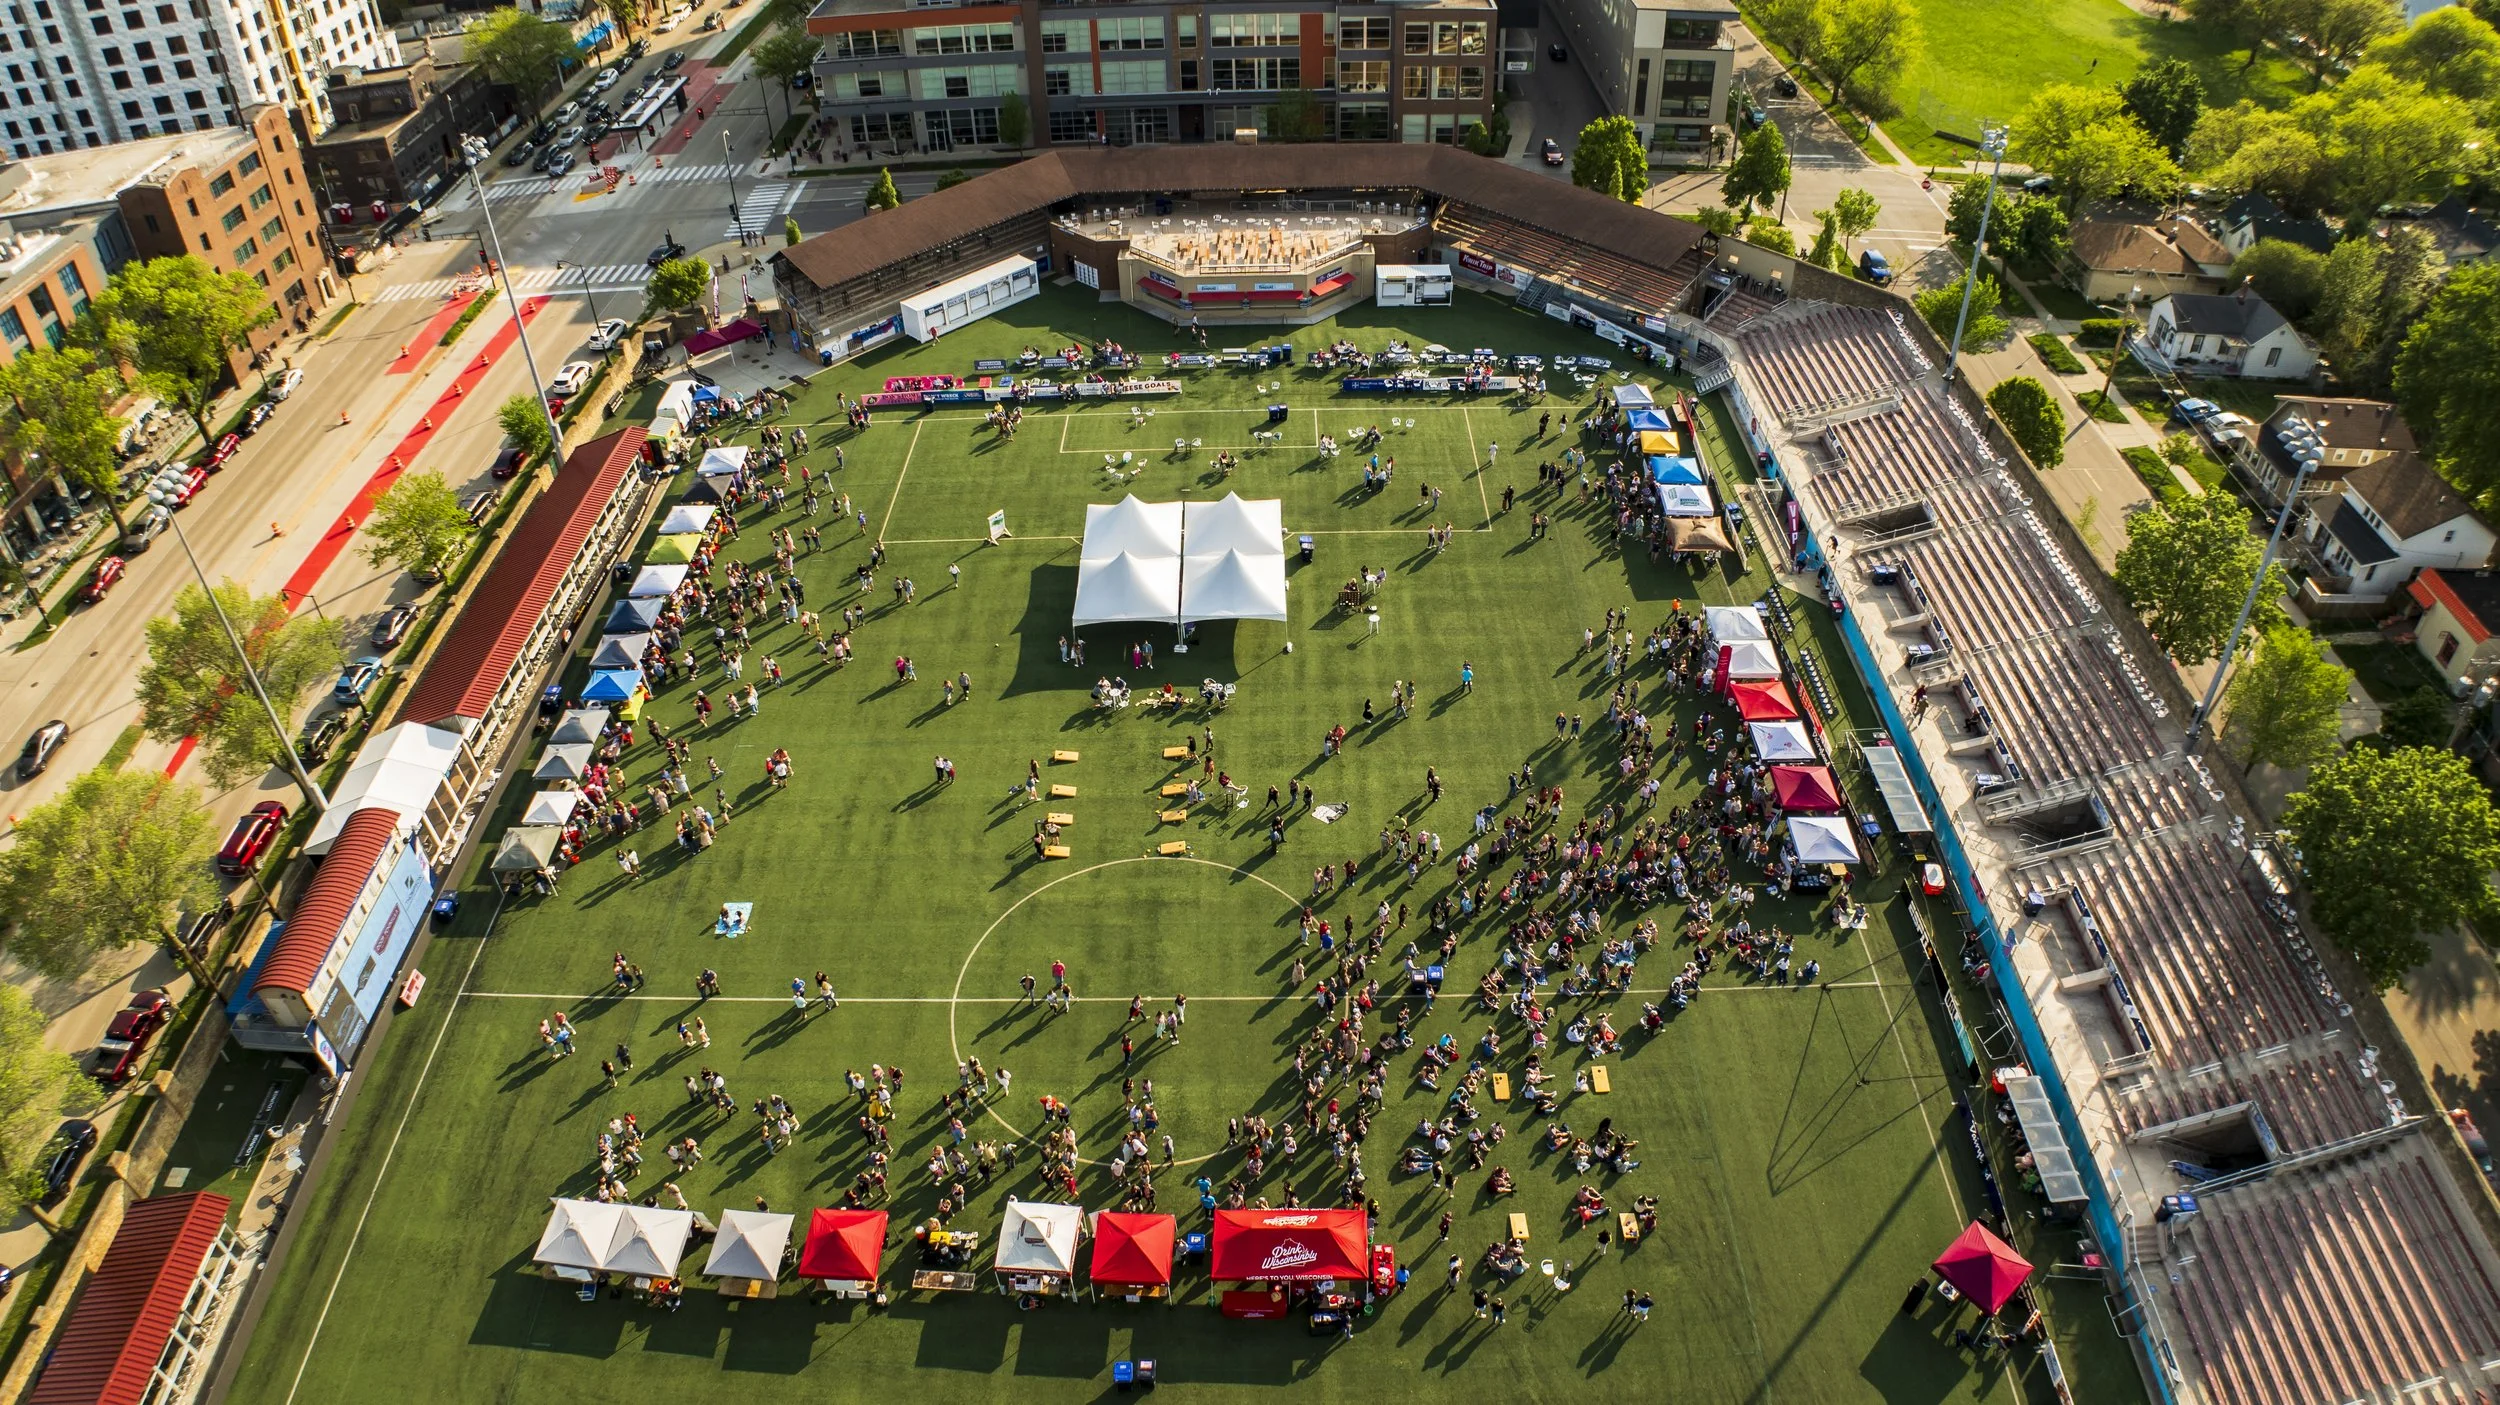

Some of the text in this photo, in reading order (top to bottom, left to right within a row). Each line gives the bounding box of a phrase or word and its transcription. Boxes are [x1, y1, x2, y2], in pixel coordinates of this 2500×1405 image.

[1479, 260, 1493, 271] TRIP
[1145, 381, 1171, 389] GOALS
[1789, 505, 1798, 544] VIP
[320, 1003, 330, 1017] VW
[1272, 1243, 1303, 1259] Drink
[1261, 1251, 1317, 1270] Wisconsinbly
